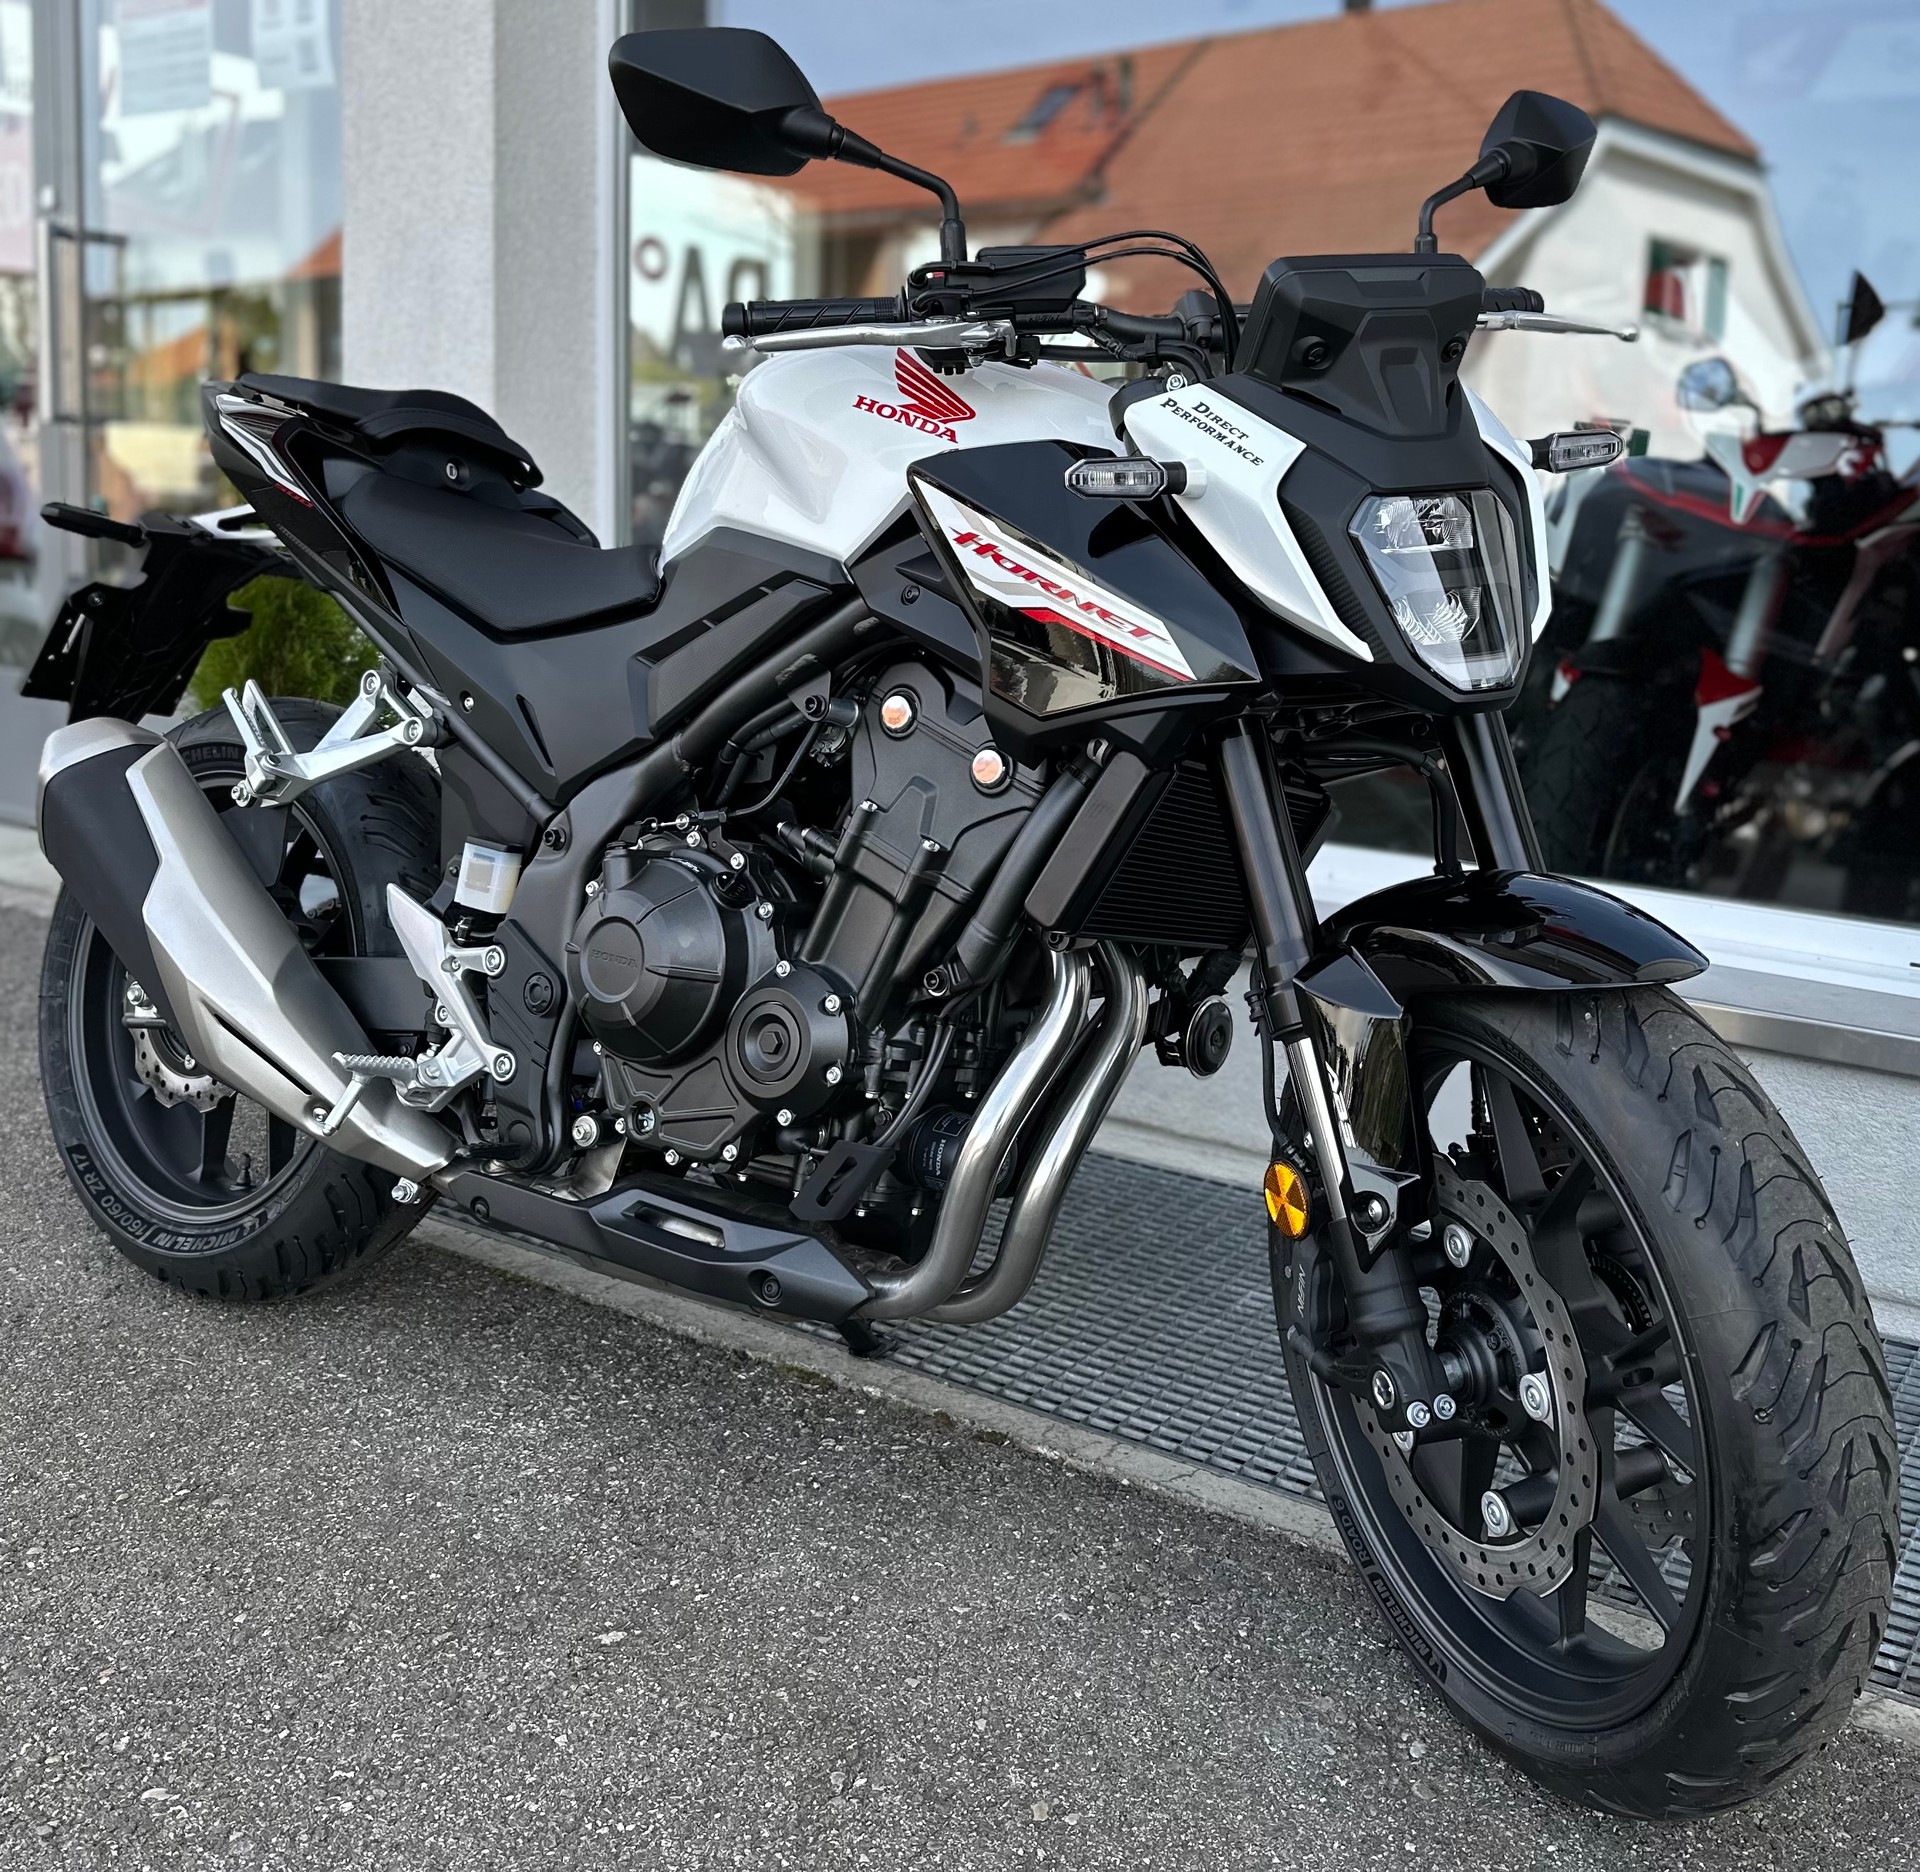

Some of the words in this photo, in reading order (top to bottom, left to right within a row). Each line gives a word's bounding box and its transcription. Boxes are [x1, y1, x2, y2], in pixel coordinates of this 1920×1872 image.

[852, 394, 959, 444] HONDA
[1159, 397, 1265, 466] PERFORMANCE
[1191, 401, 1249, 440] DIRECT
[949, 526, 1172, 643] HORNET
[181, 745, 240, 765] CHELIN
[592, 948, 638, 968] HONDA
[72, 1152, 91, 1172] 17
[935, 1138, 947, 1176] HONDA
[84, 1172, 106, 1194] ZR
[100, 1194, 148, 1239] 160/60
[154, 1228, 238, 1250] MICHELIN
[1335, 1499, 1347, 1512] 6
[1341, 1515, 1370, 1564] ROAD
[1373, 1577, 1431, 1658] MICHELIN
